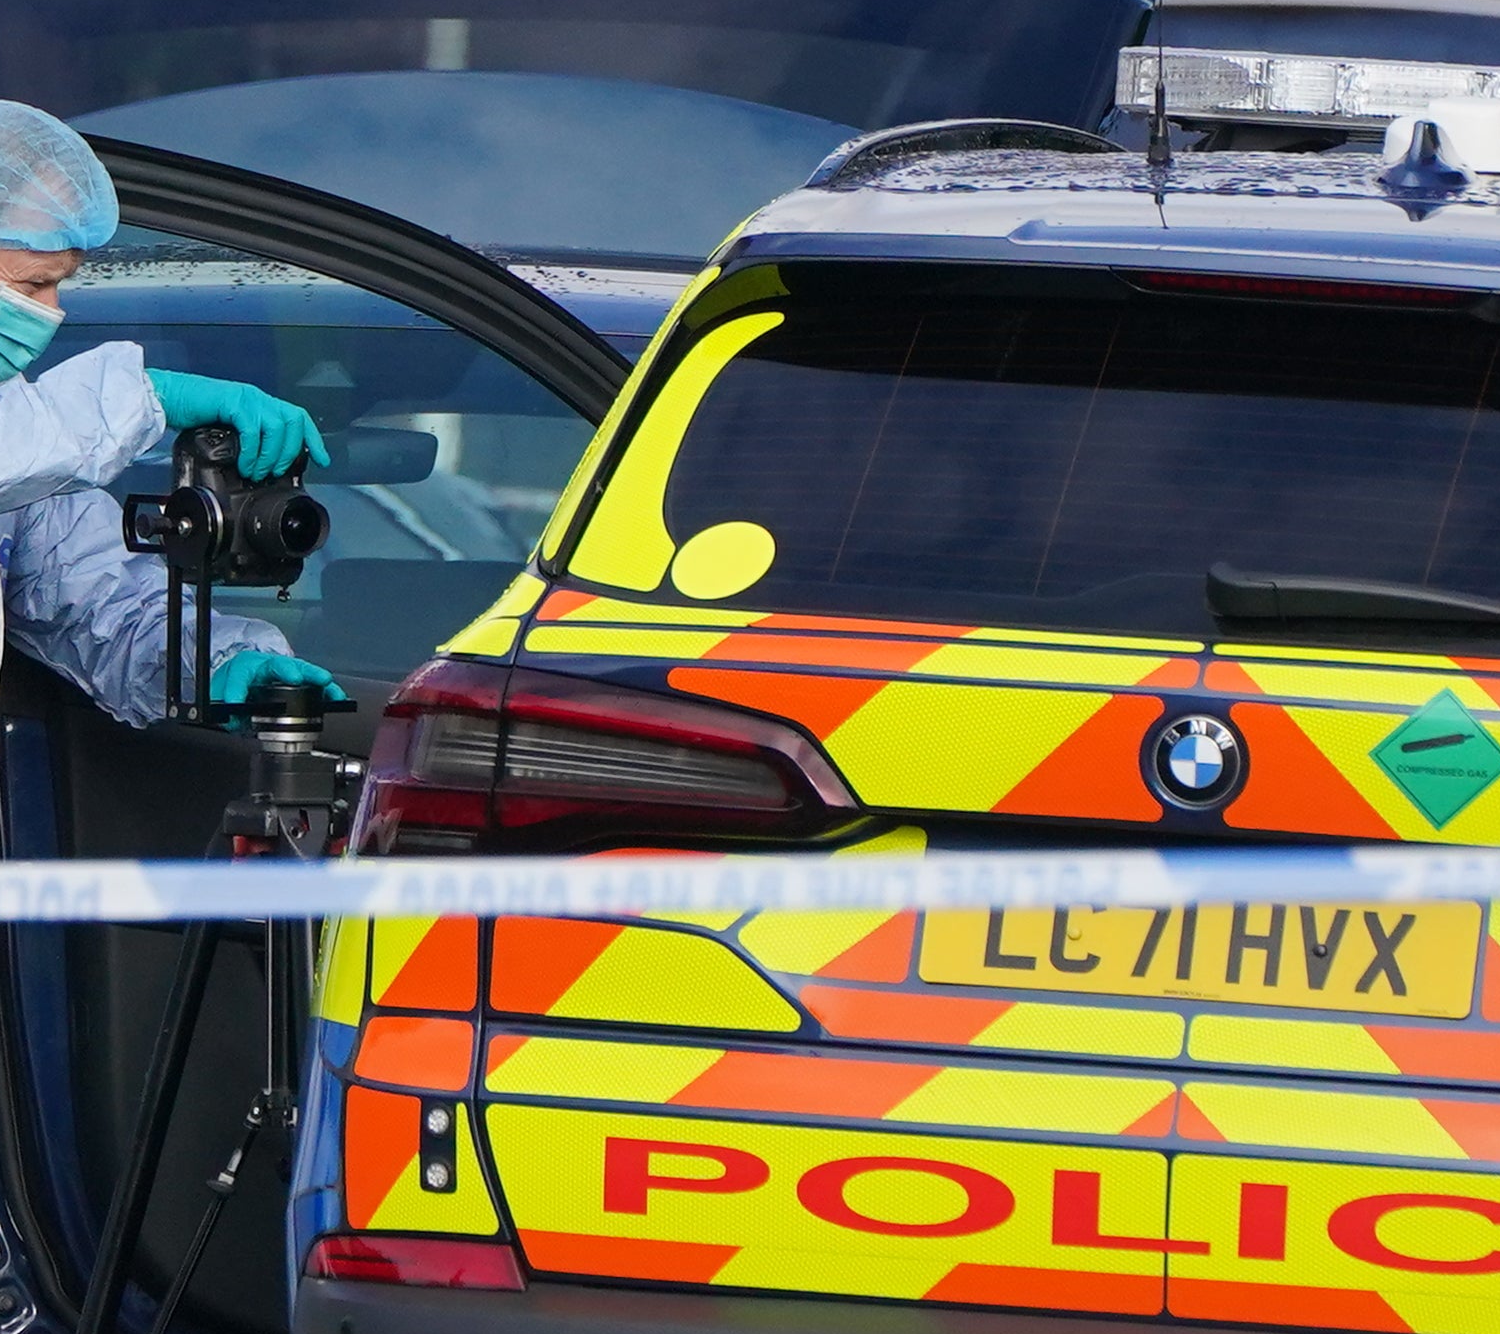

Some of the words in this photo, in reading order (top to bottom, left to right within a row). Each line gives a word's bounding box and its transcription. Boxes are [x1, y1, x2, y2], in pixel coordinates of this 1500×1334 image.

[1163, 719, 1235, 751] BMW
[1396, 764, 1465, 778] COMPRESSED
[1467, 769, 1489, 778] GAS
[1224, 901, 1418, 997] HVX
